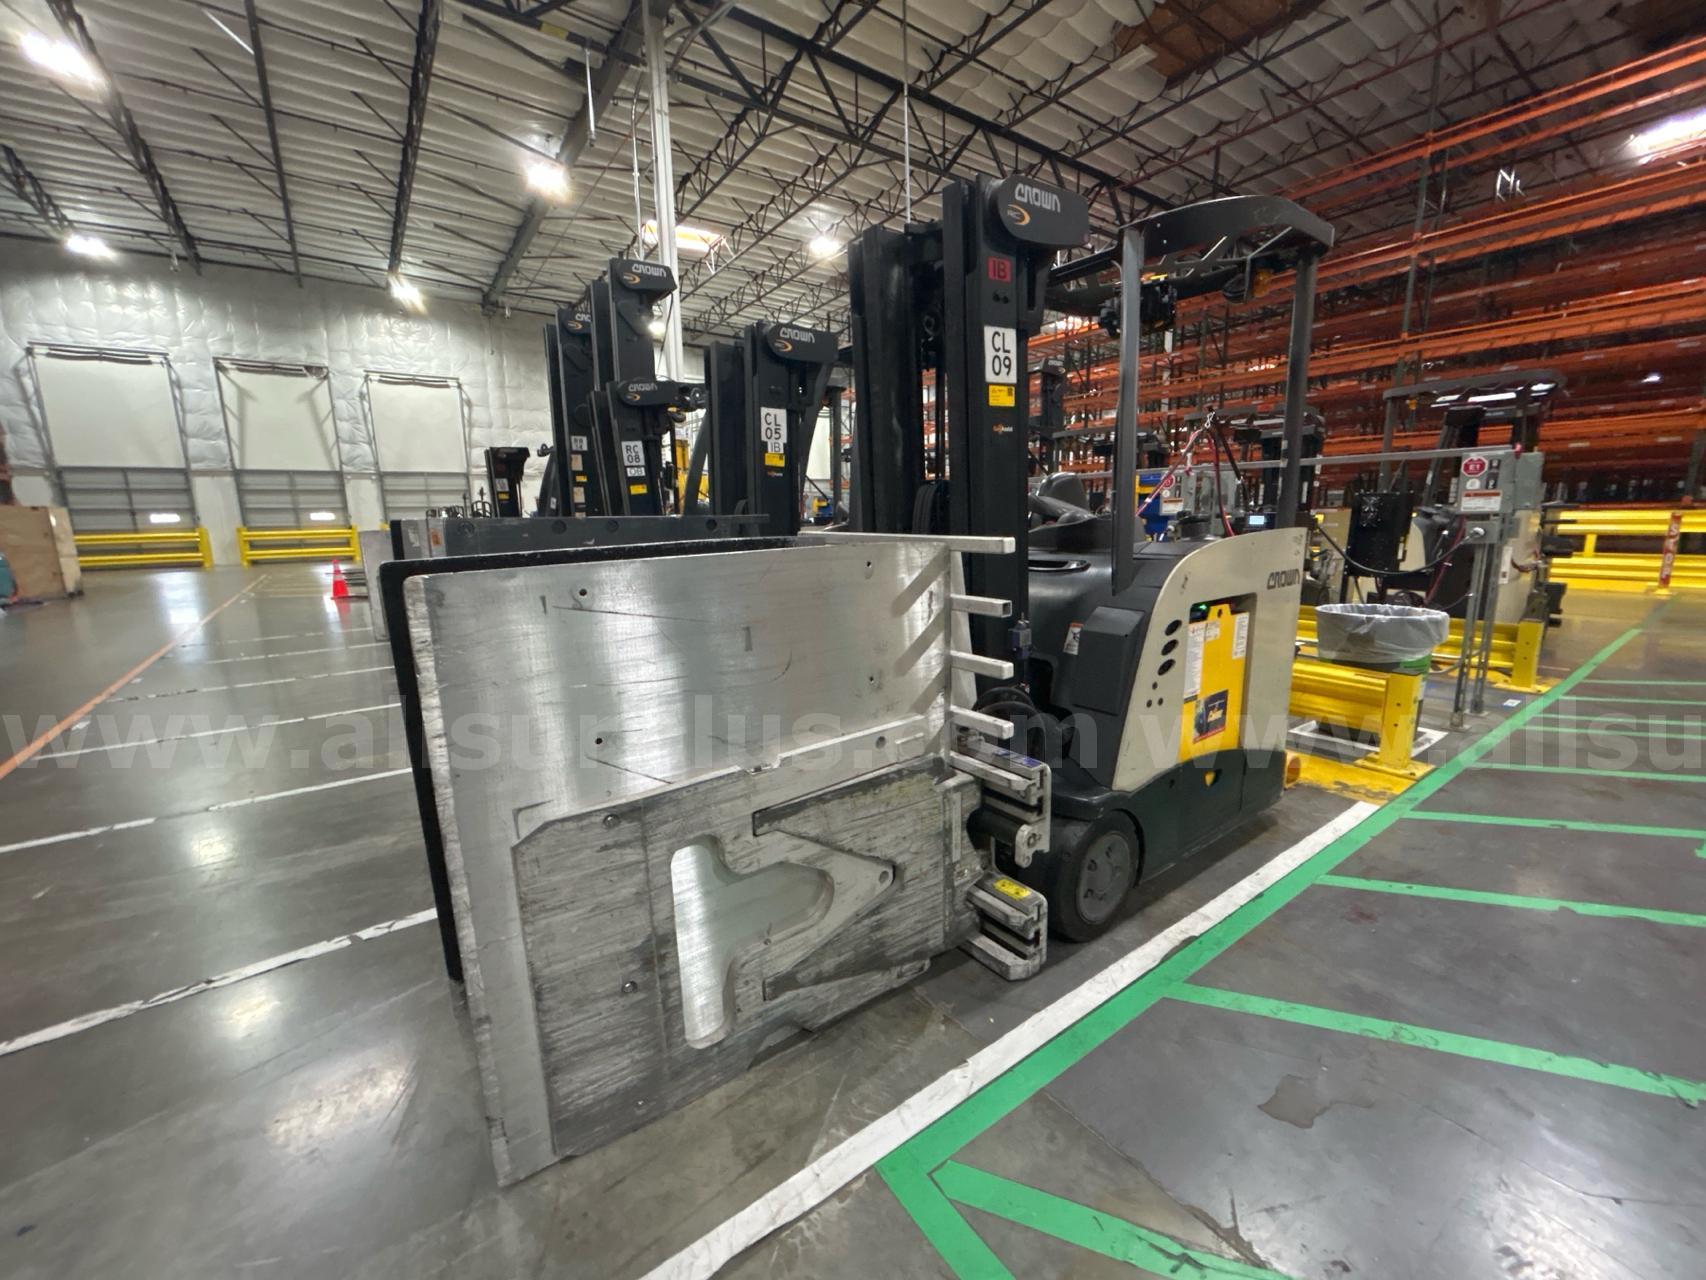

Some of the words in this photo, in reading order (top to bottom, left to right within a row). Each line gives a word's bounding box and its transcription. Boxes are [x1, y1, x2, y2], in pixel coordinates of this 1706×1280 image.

[1014, 183, 1061, 213] CROWN
[632, 264, 667, 278] CROWN
[779, 327, 816, 344] CROWN
[991, 331, 1011, 354] CL
[991, 355, 1012, 376] 09
[764, 412, 782, 427] CL
[764, 428, 782, 440] 05
[625, 444, 639, 454] RC
[626, 454, 642, 464] 08
[1266, 568, 1301, 590] CROWN
